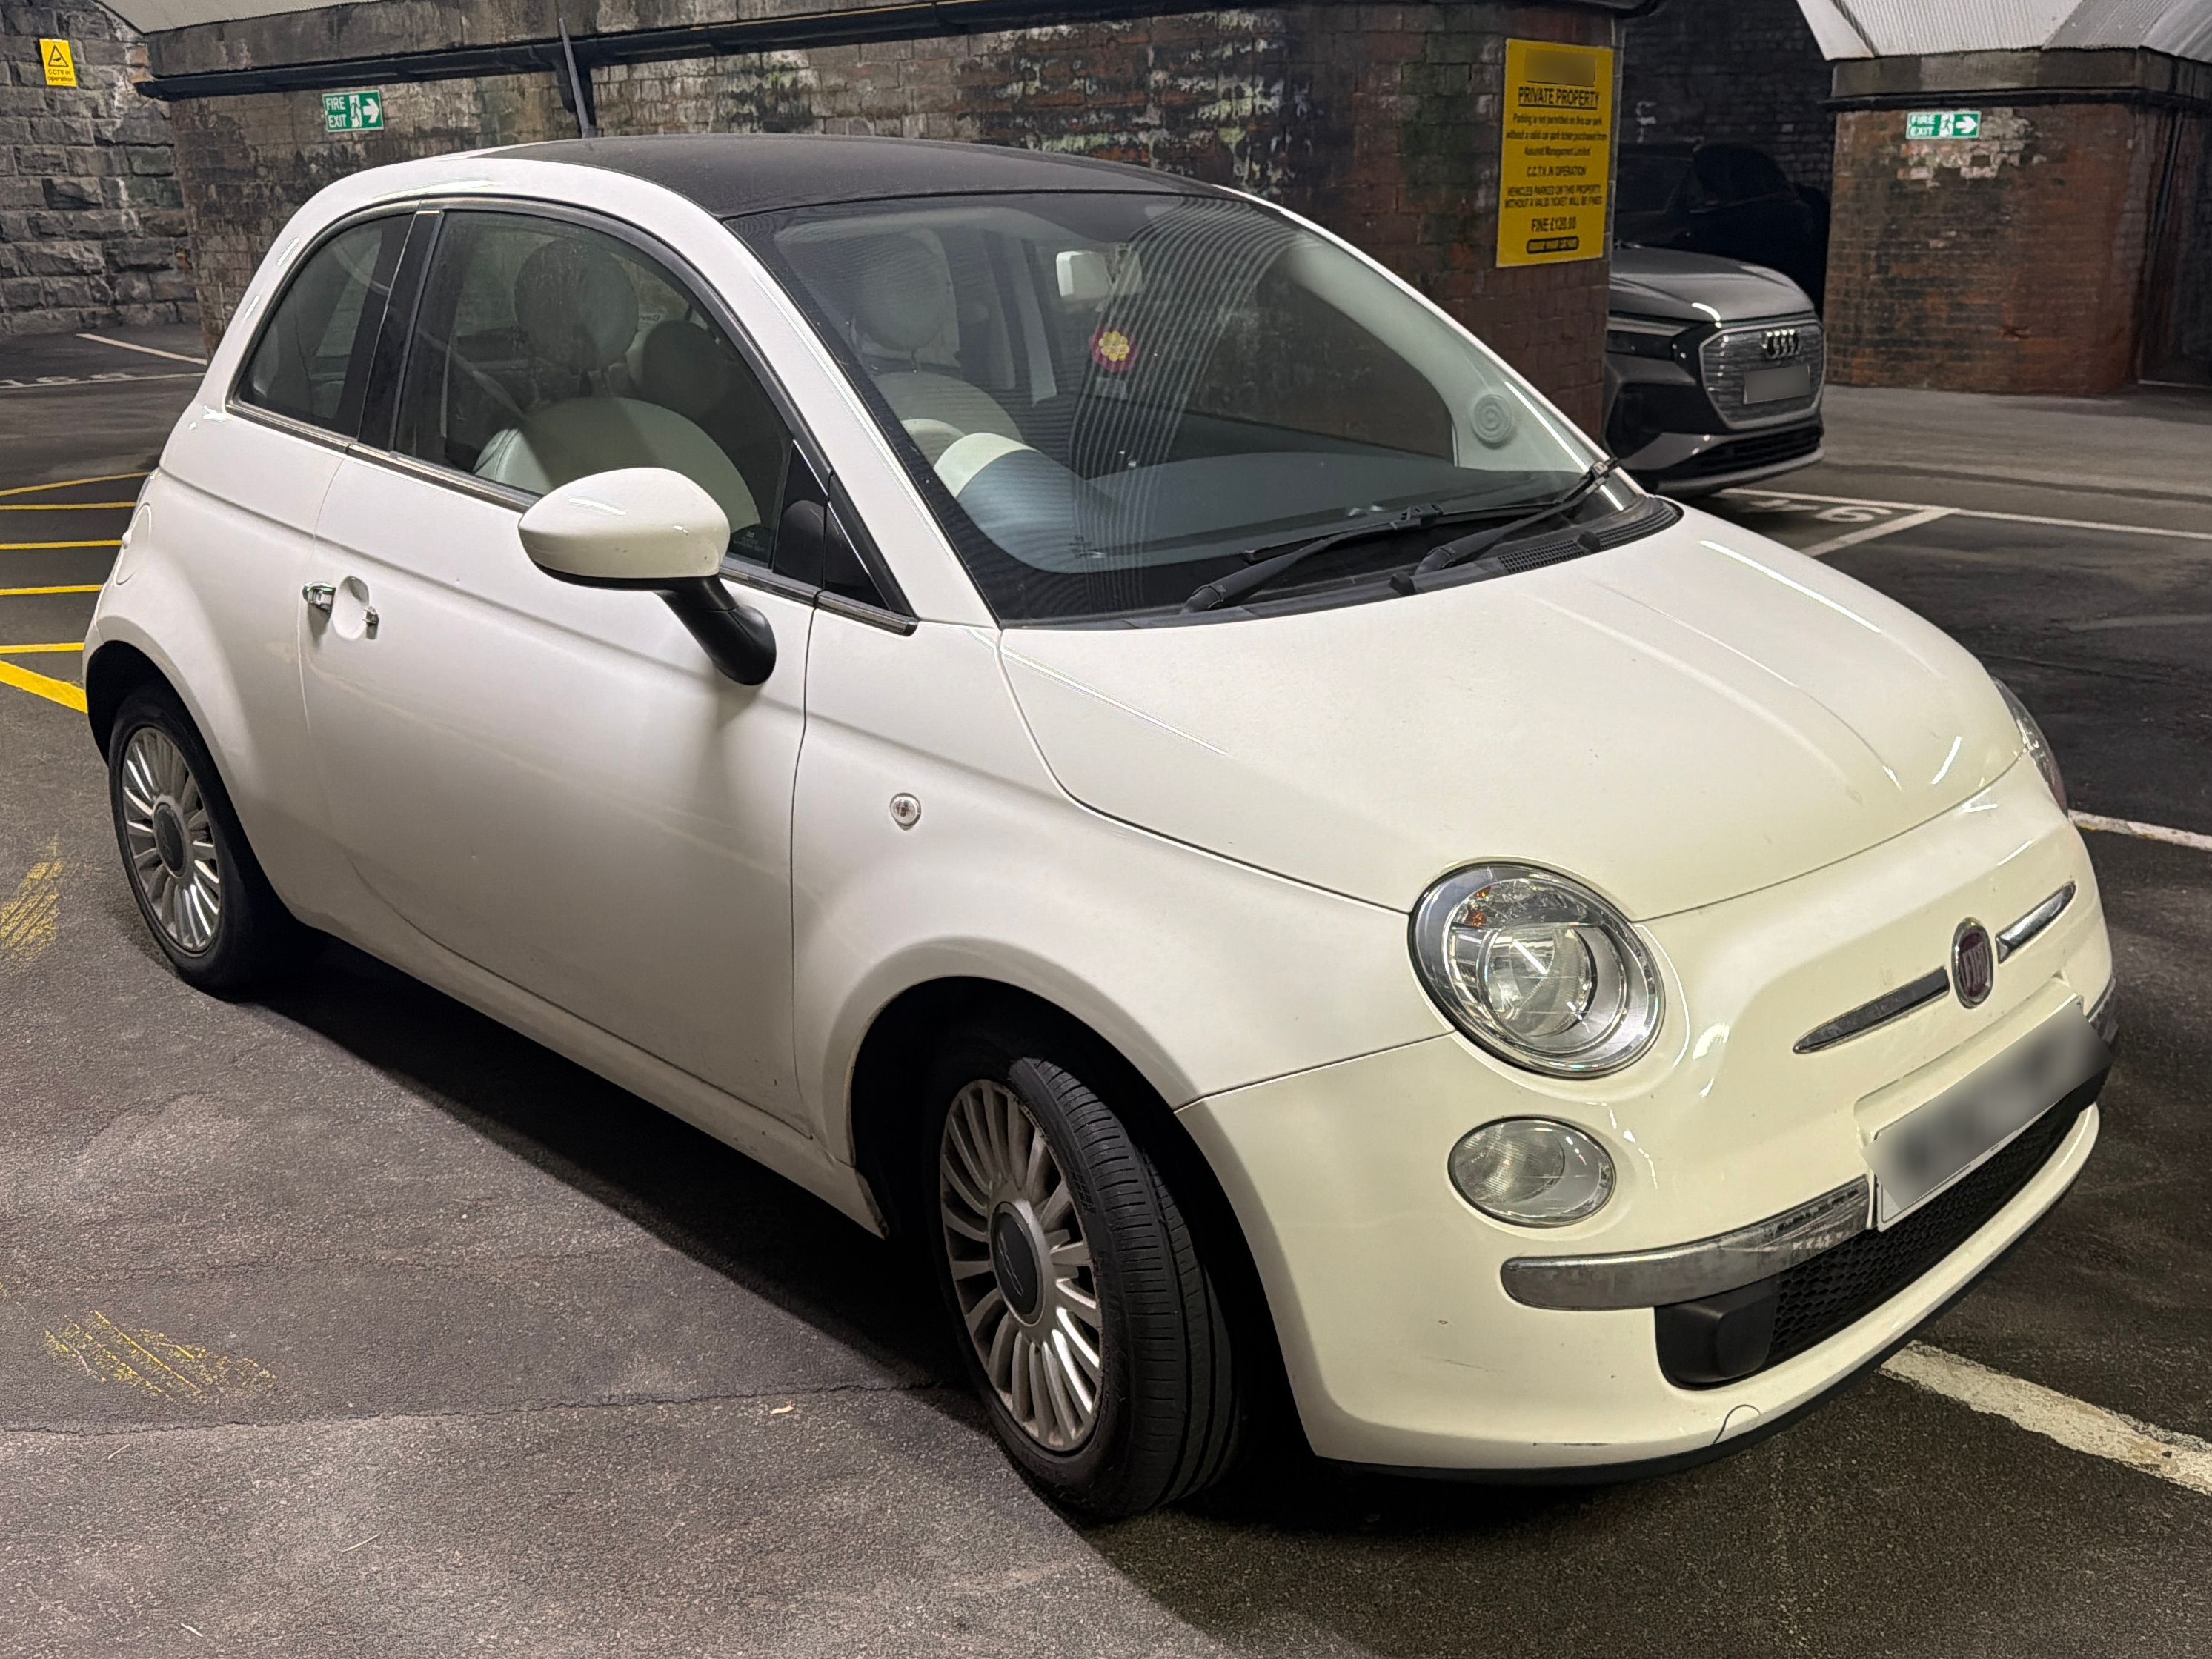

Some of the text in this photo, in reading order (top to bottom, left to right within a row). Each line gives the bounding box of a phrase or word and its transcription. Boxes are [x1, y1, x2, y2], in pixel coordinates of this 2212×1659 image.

[325, 96, 346, 110] FIRE
[1518, 87, 1599, 105] PRIVATE PROPERTY
[328, 113, 347, 128] EXIT
[1911, 115, 1935, 124] FIRE
[1910, 126, 1933, 136] EXIT
[1555, 165, 1586, 176] OPERATION
[1531, 217, 1550, 232] FINE
